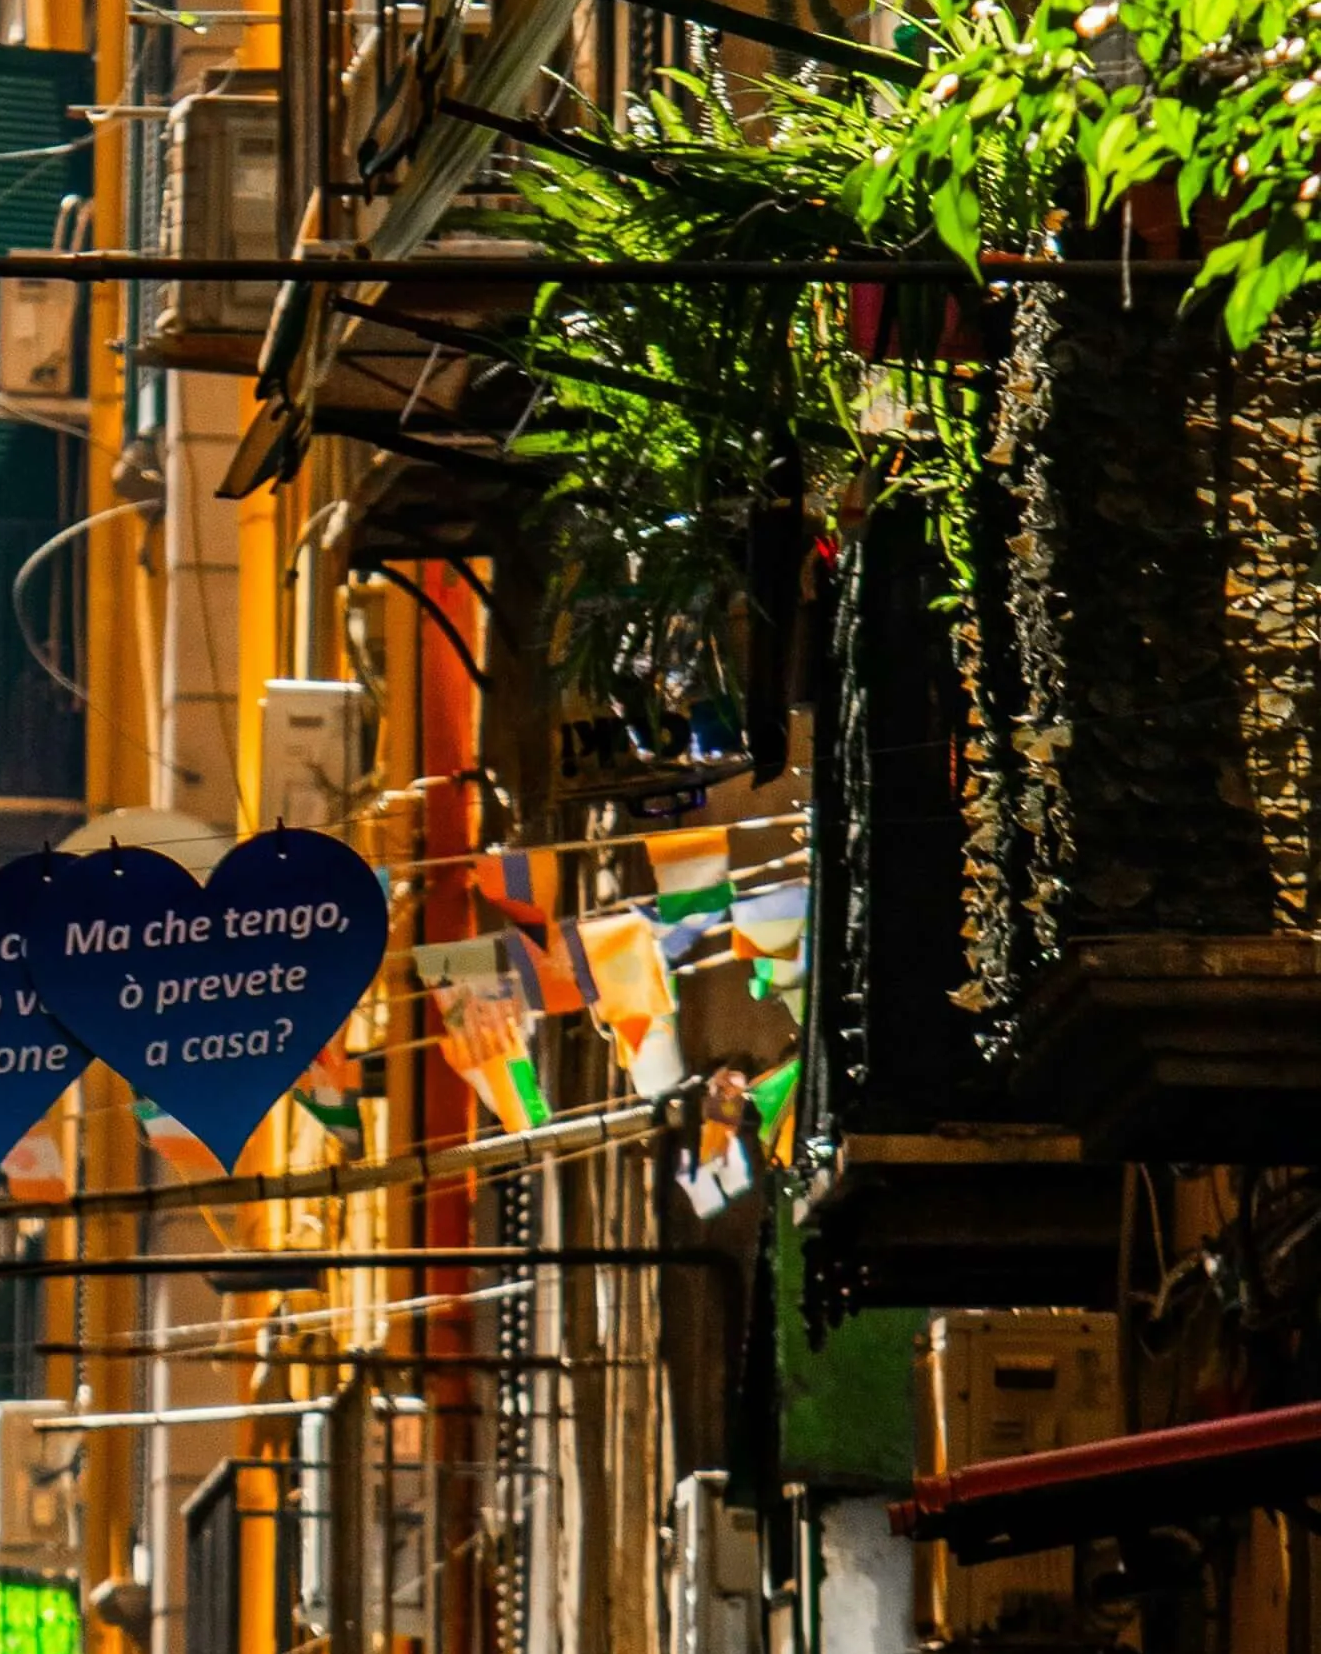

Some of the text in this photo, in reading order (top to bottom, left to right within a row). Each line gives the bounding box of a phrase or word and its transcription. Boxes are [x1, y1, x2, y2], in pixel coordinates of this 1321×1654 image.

[0, 932, 27, 961] c
[64, 901, 350, 956] Ma che tengo,
[15, 990, 48, 1017] v
[119, 962, 308, 1015] ò prevete
[145, 1017, 294, 1067] a casa?
